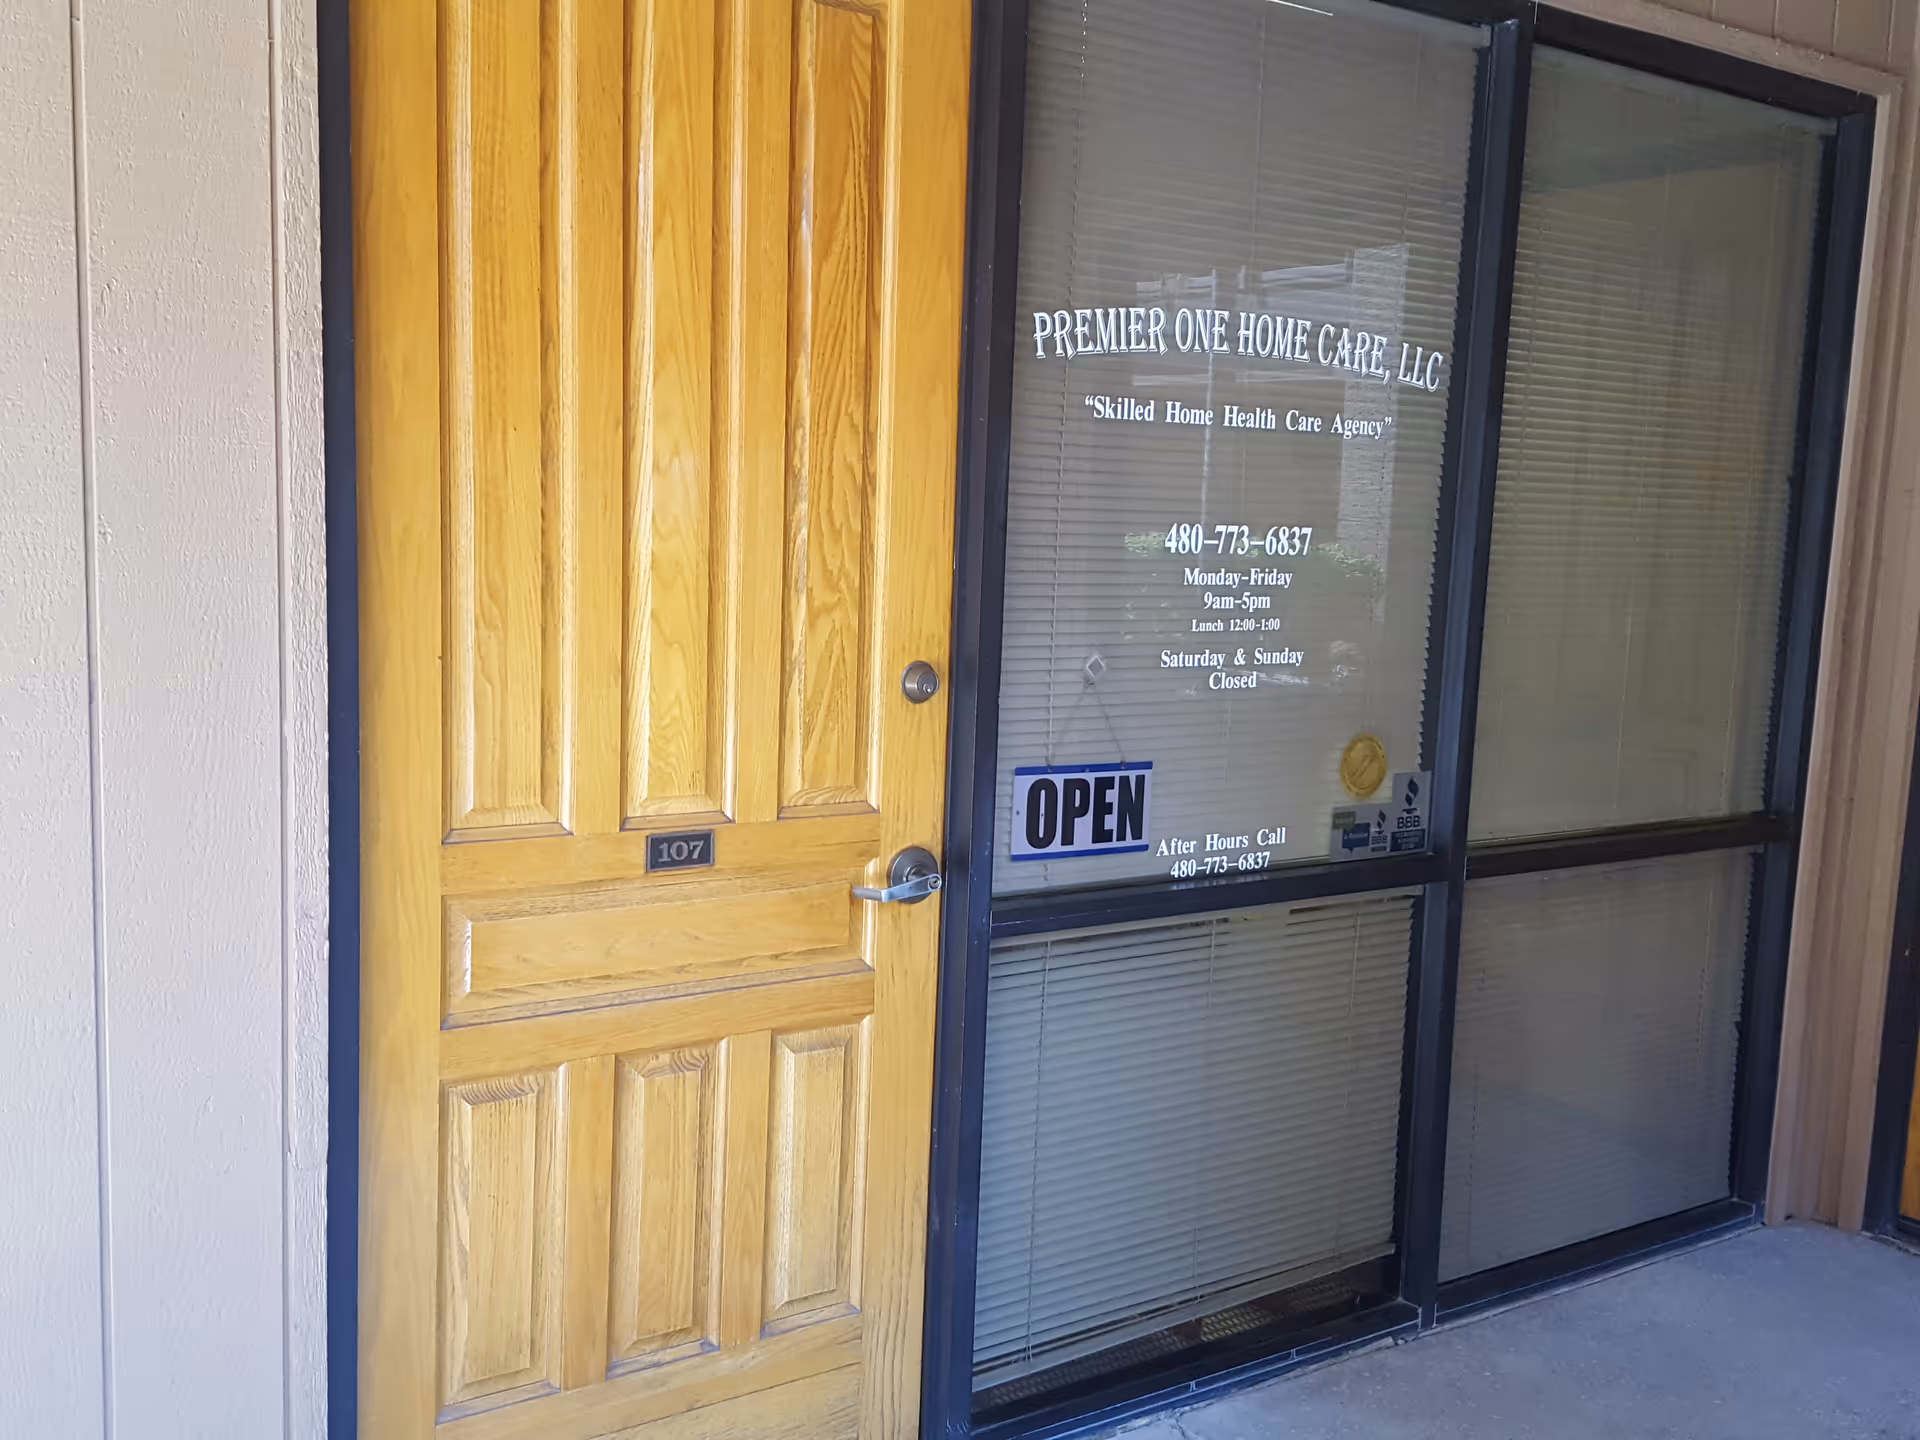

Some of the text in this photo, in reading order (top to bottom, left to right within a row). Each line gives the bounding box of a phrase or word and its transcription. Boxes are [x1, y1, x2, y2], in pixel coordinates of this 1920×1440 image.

[1033, 307, 1444, 393] PREMIER ONE HOME CARE, LLC
[1165, 401, 1214, 425] Home
[1223, 405, 1276, 430] Health
[1285, 409, 1322, 433] Care
[1164, 522, 1312, 556] 480-773-6837
[1183, 567, 1293, 589] Monday-Friday
[1203, 592, 1270, 613] 9am-5pm
[1191, 618, 1280, 632] Lunch 12:00-1:00
[1160, 647, 1304, 669] Saturday & Sunday
[1209, 671, 1258, 690] Closed
[1025, 774, 1146, 849] OPEN
[1397, 815, 1421, 829] BBB
[658, 840, 704, 862] 107
[1156, 827, 1286, 858] After Hours Call
[1170, 852, 1270, 879] 480-773-6837
